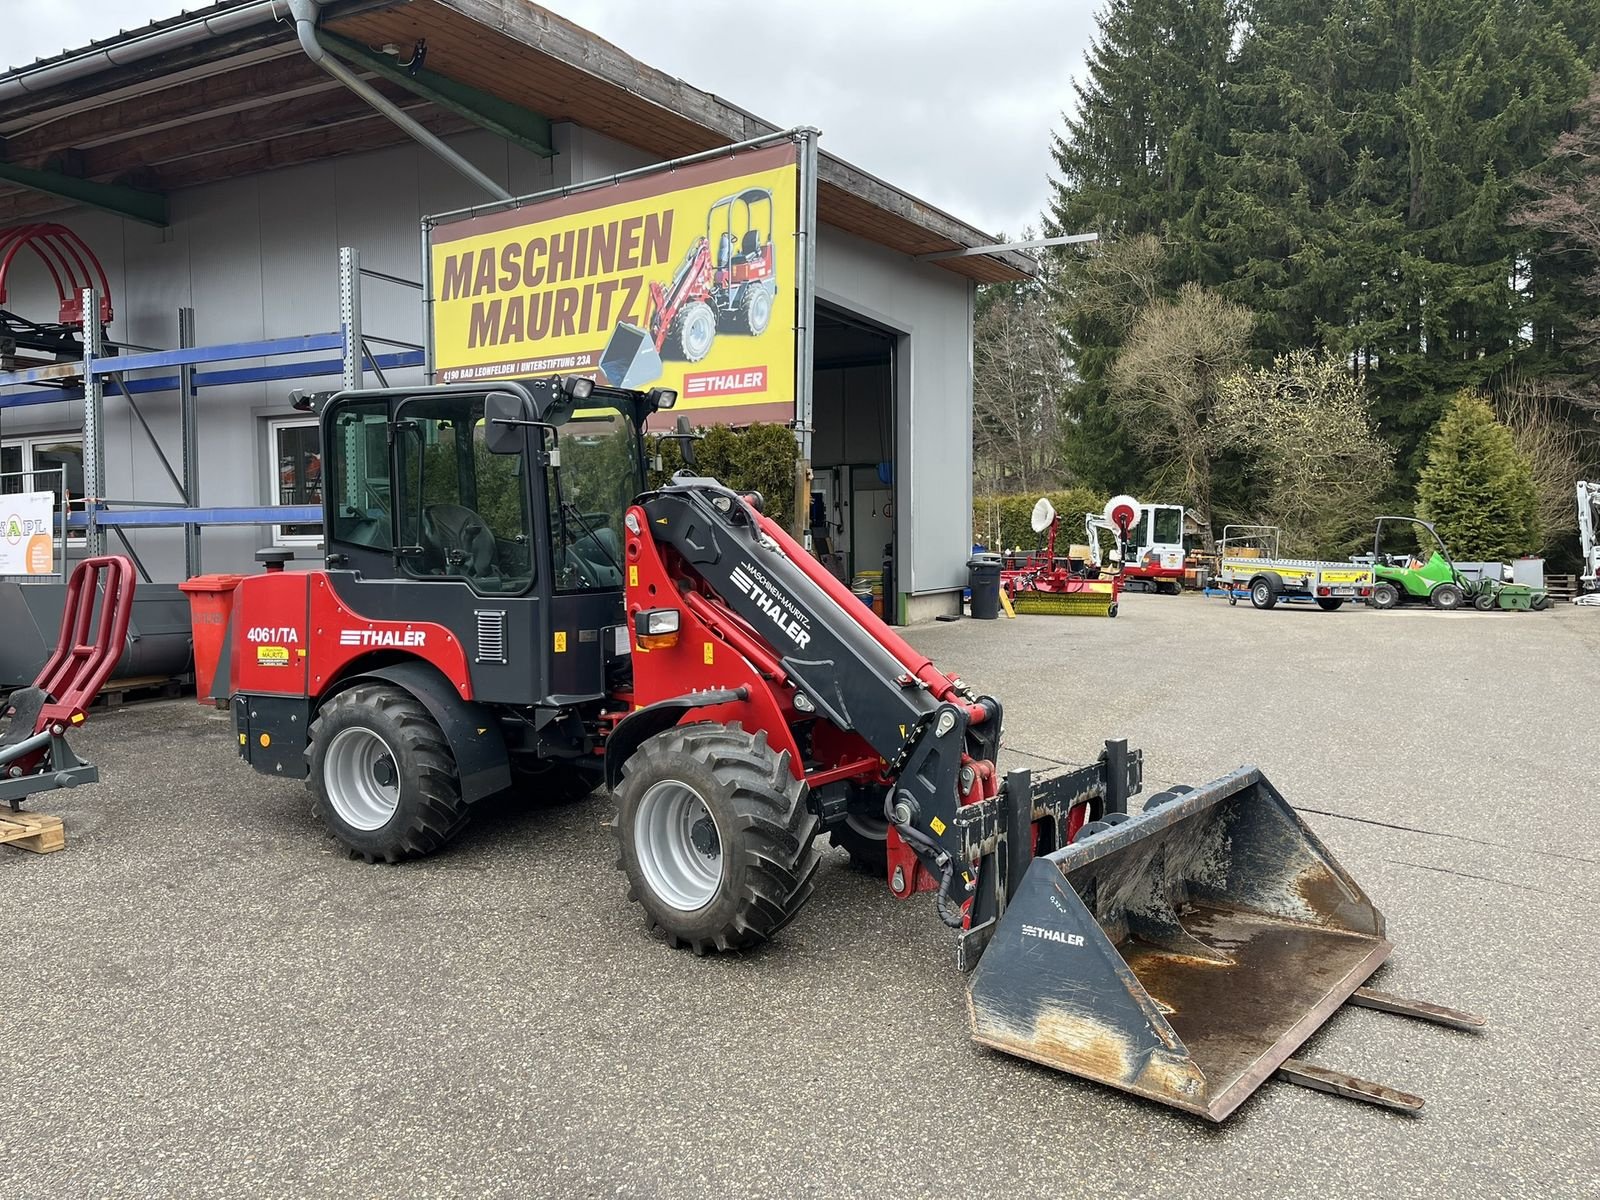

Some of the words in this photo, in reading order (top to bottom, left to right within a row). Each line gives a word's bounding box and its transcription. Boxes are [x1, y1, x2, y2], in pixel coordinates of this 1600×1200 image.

[441, 208, 674, 301] MASCHINEN
[467, 275, 644, 349] MAURITZ
[443, 371, 459, 380] 4190
[460, 369, 473, 378] BAD
[474, 364, 515, 377] LEONFELDEN
[520, 357, 575, 372] UNTERSTIFTUNG
[576, 355, 591, 366] 23A
[705, 372, 763, 391] THALER
[750, 583, 811, 650] THALER
[247, 627, 298, 643] 4061/TA
[361, 630, 426, 646] THALER
[1036, 927, 1085, 947] THALER
